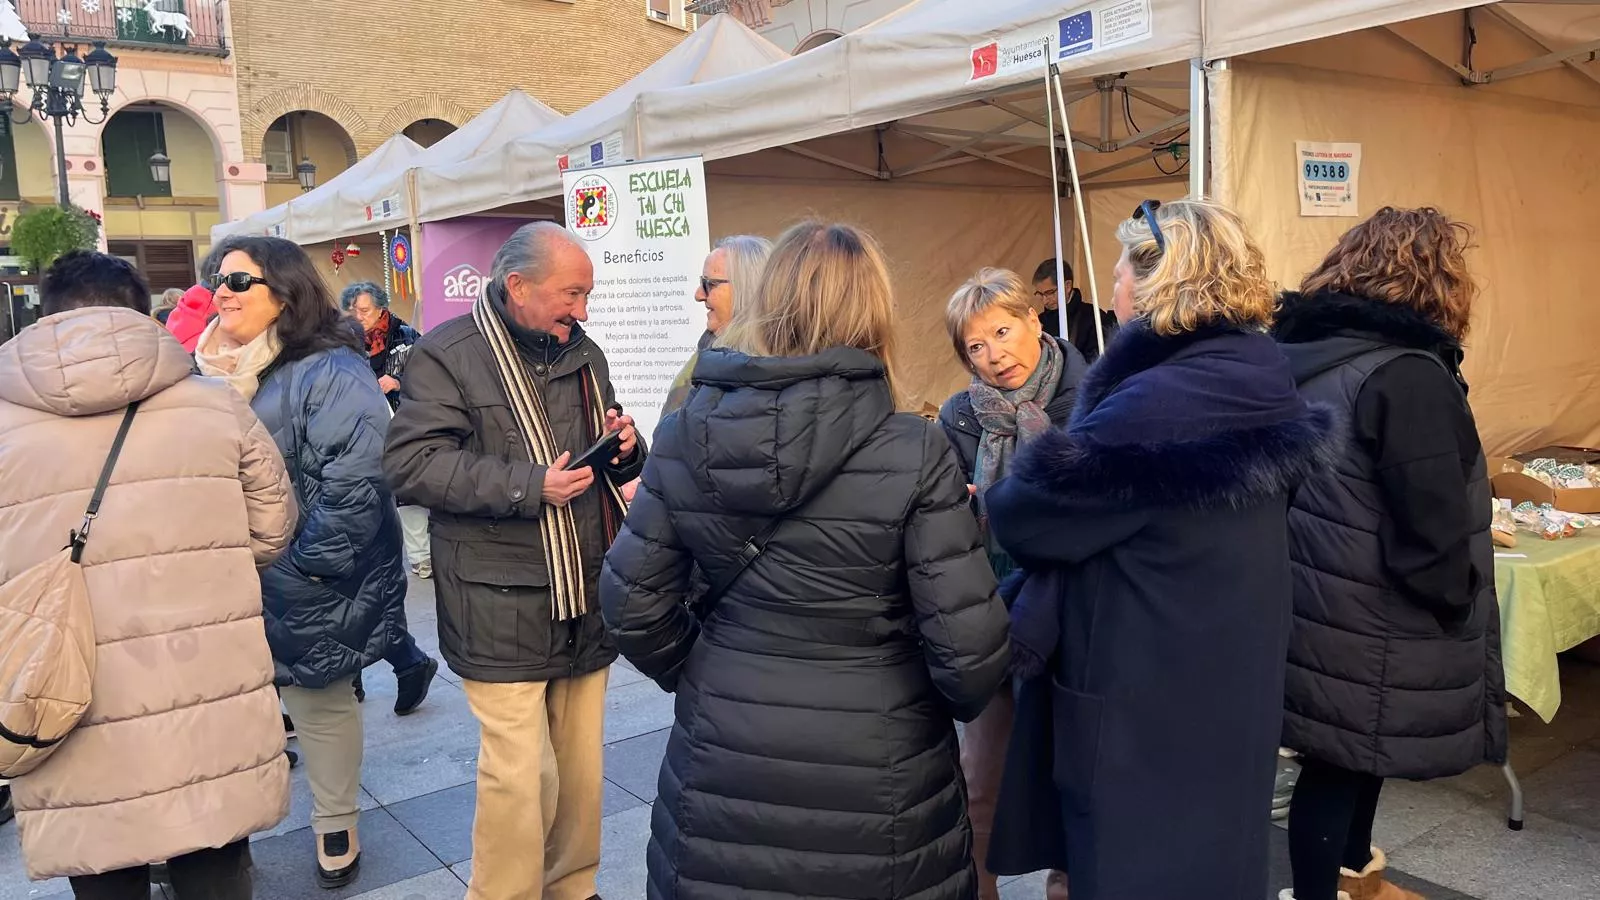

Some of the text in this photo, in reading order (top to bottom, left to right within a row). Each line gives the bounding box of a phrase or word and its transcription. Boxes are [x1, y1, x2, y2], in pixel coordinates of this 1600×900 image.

[1001, 49, 1042, 67] de Huesca
[1305, 164, 1345, 178] 99388
[629, 168, 691, 194] ESCUELA
[637, 192, 685, 217] TAI CHI
[636, 216, 691, 239] HUESCA
[604, 249, 664, 264] Beneficios
[616, 277, 627, 285] los
[628, 276, 651, 285] dolores
[653, 275, 661, 283] de
[608, 291, 615, 299] la
[588, 305, 605, 314] Alivio
[607, 305, 616, 313] de
[617, 305, 624, 313] la
[647, 306, 651, 314] y
[652, 303, 658, 311] la
[648, 319, 652, 327] y
[653, 317, 660, 325] la
[605, 333, 630, 342] Mejora
[630, 332, 637, 340] la
[603, 346, 610, 354] la
[611, 346, 647, 355] capacidad
[609, 359, 642, 368] coordinar
[643, 359, 653, 367] los
[624, 373, 631, 381] el
[619, 386, 626, 394] la
[627, 386, 651, 394] calidad
[652, 386, 663, 394] del
[657, 401, 661, 409] y
